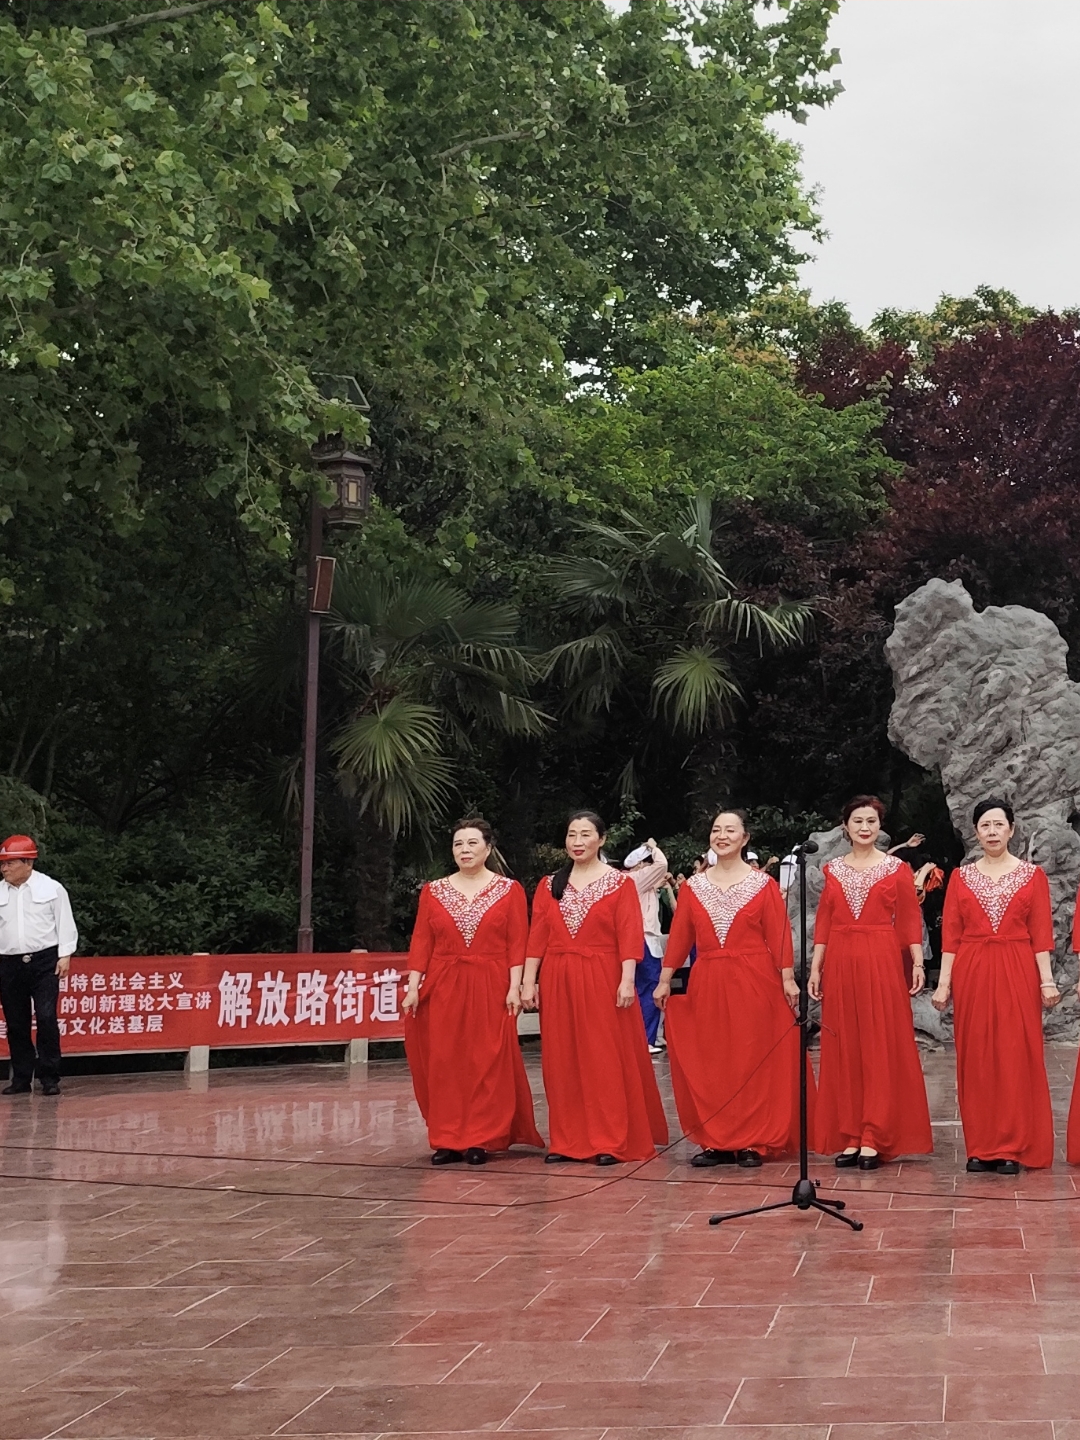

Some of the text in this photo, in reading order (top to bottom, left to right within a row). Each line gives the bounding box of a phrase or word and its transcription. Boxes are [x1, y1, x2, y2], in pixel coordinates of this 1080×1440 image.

[60, 991, 212, 1014] 的创新理论大宣讲
[217, 968, 426, 1028] 解放路街道
